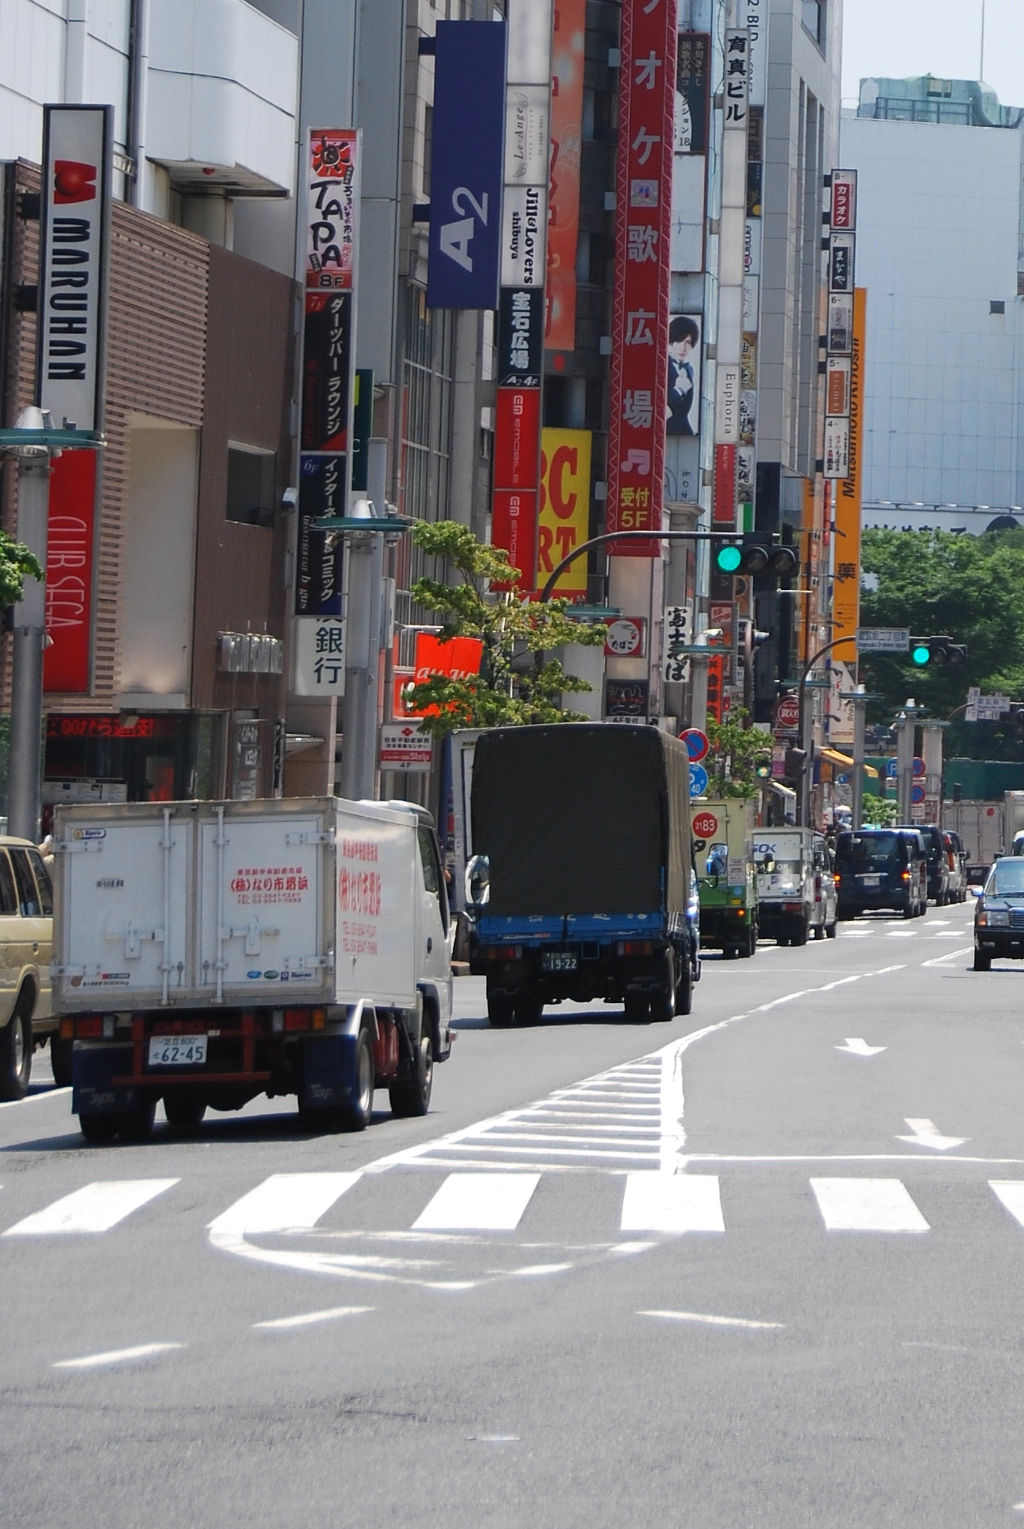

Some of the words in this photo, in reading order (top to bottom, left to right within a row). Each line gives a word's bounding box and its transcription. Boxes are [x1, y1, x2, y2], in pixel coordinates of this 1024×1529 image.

[679, 137, 691, 146] 18
[310, 179, 344, 267] TAPA
[440, 186, 489, 272] A2
[836, 184, 848, 226] カラオケ
[511, 211, 521, 260] shibuya
[48, 216, 90, 381] MARUHAN
[319, 274, 344, 288] 8F
[329, 297, 345, 371] ダーツバー
[509, 291, 531, 370] 宝石広場
[622, 225, 659, 428] 歌広場
[327, 376, 342, 436] ラウンジ
[724, 374, 736, 435] Euphoria
[620, 487, 650, 508] 受付
[621, 510, 648, 528] 5F
[321, 458, 339, 602] インターネ&コミック
[299, 574, 310, 609] bgus
[314, 619, 343, 684] 銀行
[611, 640, 633, 650] たばこ
[550, 959, 577, 969] 19-22
[161, 1046, 204, 1062] 62-45
